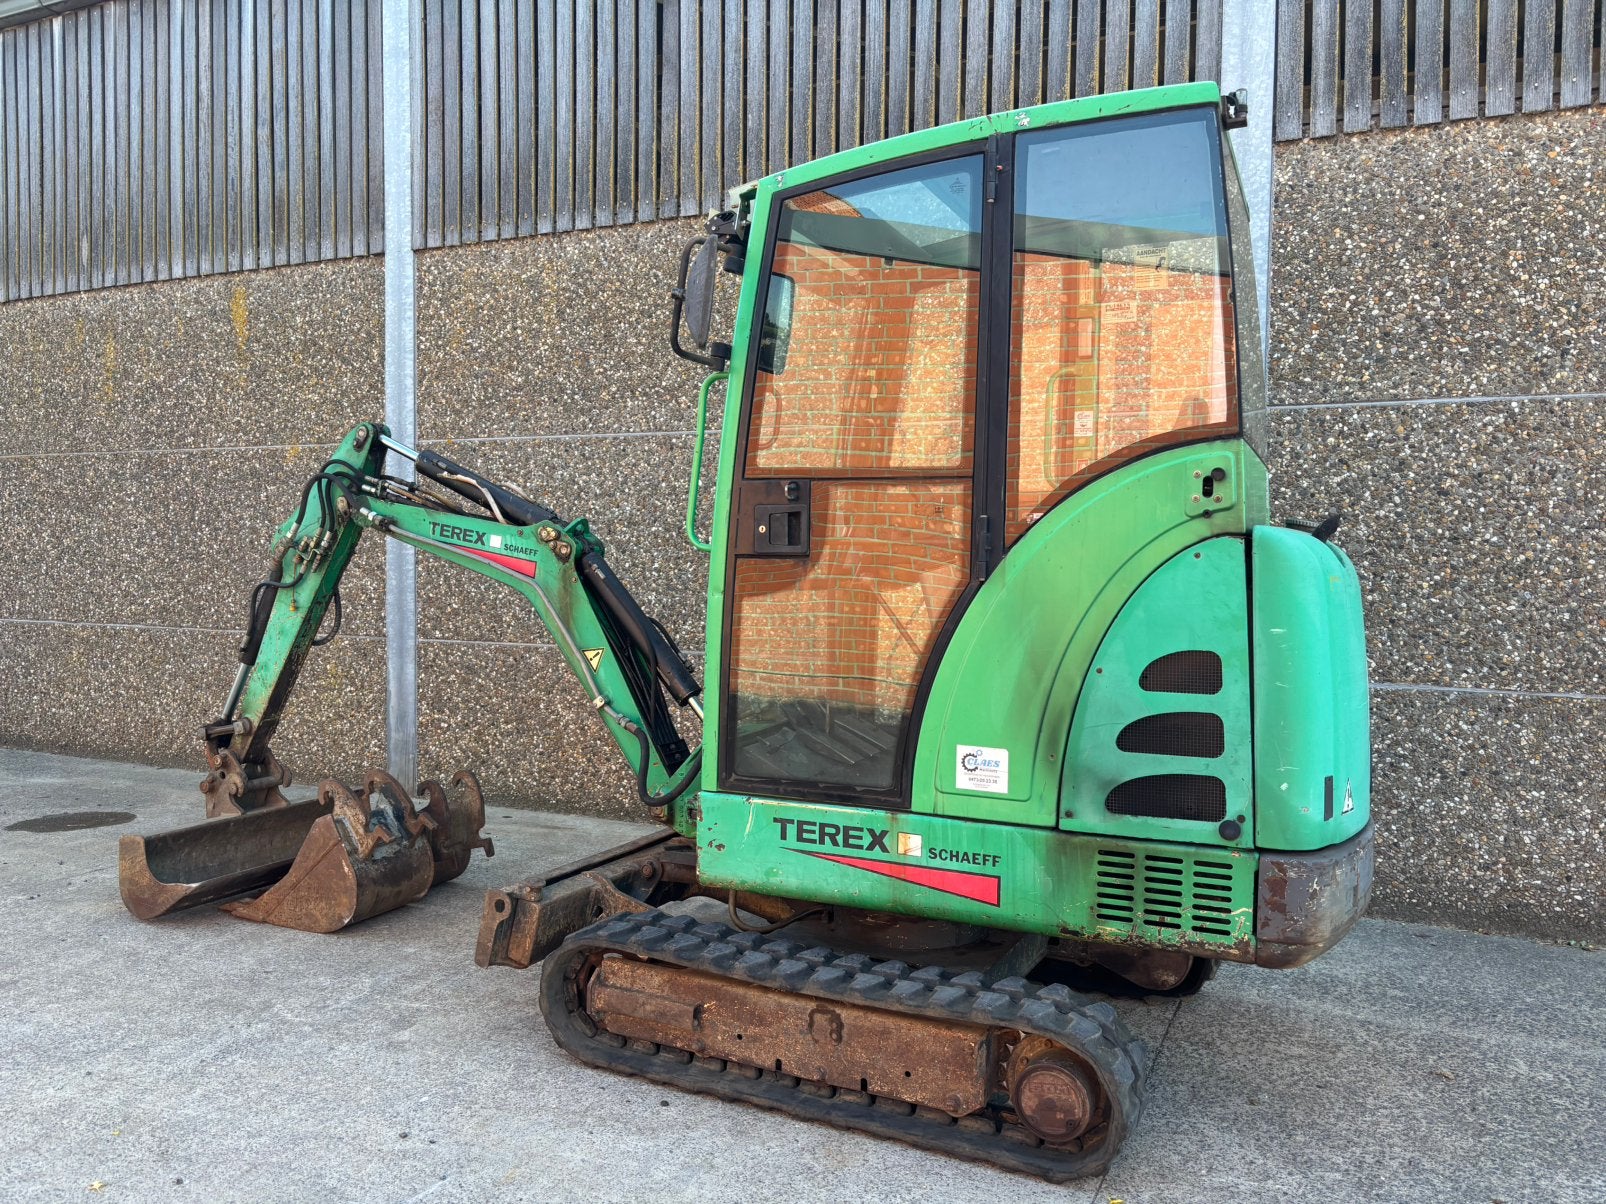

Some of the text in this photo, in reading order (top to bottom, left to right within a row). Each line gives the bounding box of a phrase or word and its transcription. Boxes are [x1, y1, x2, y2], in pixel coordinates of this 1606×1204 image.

[1136, 248, 1166, 256] AANDACHT
[430, 521, 539, 557] TEREX SCHAEFF
[967, 757, 1001, 768] CLAES
[773, 817, 1002, 868] TEREX SCHAEFF
